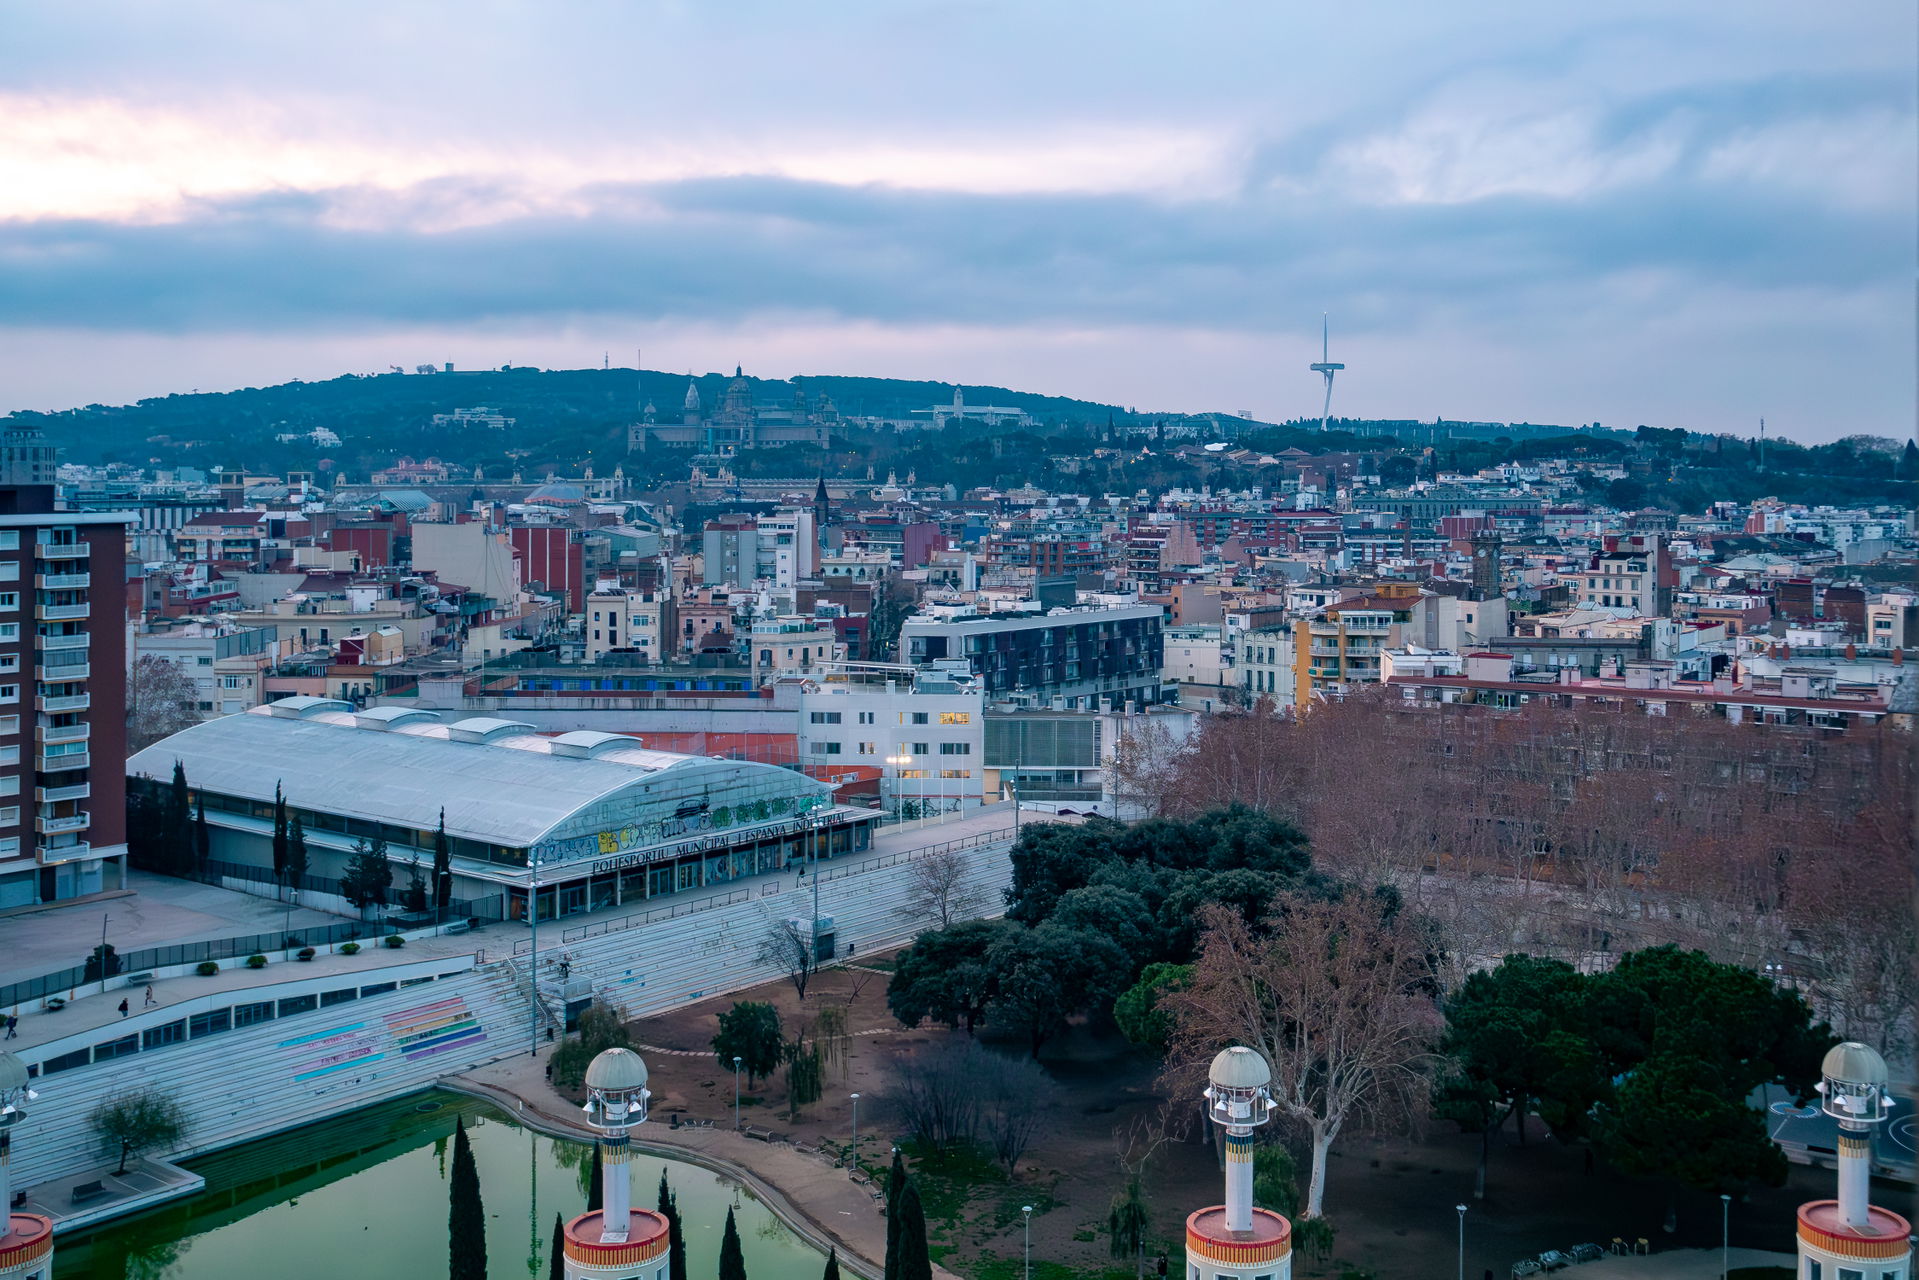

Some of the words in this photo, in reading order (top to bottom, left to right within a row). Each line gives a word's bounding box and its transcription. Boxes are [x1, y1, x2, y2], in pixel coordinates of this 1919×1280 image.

[592, 848, 669, 873] POLIESPORTIU
[676, 836, 730, 856] MUNICIPAL
[738, 825, 786, 844] LESPANYA
